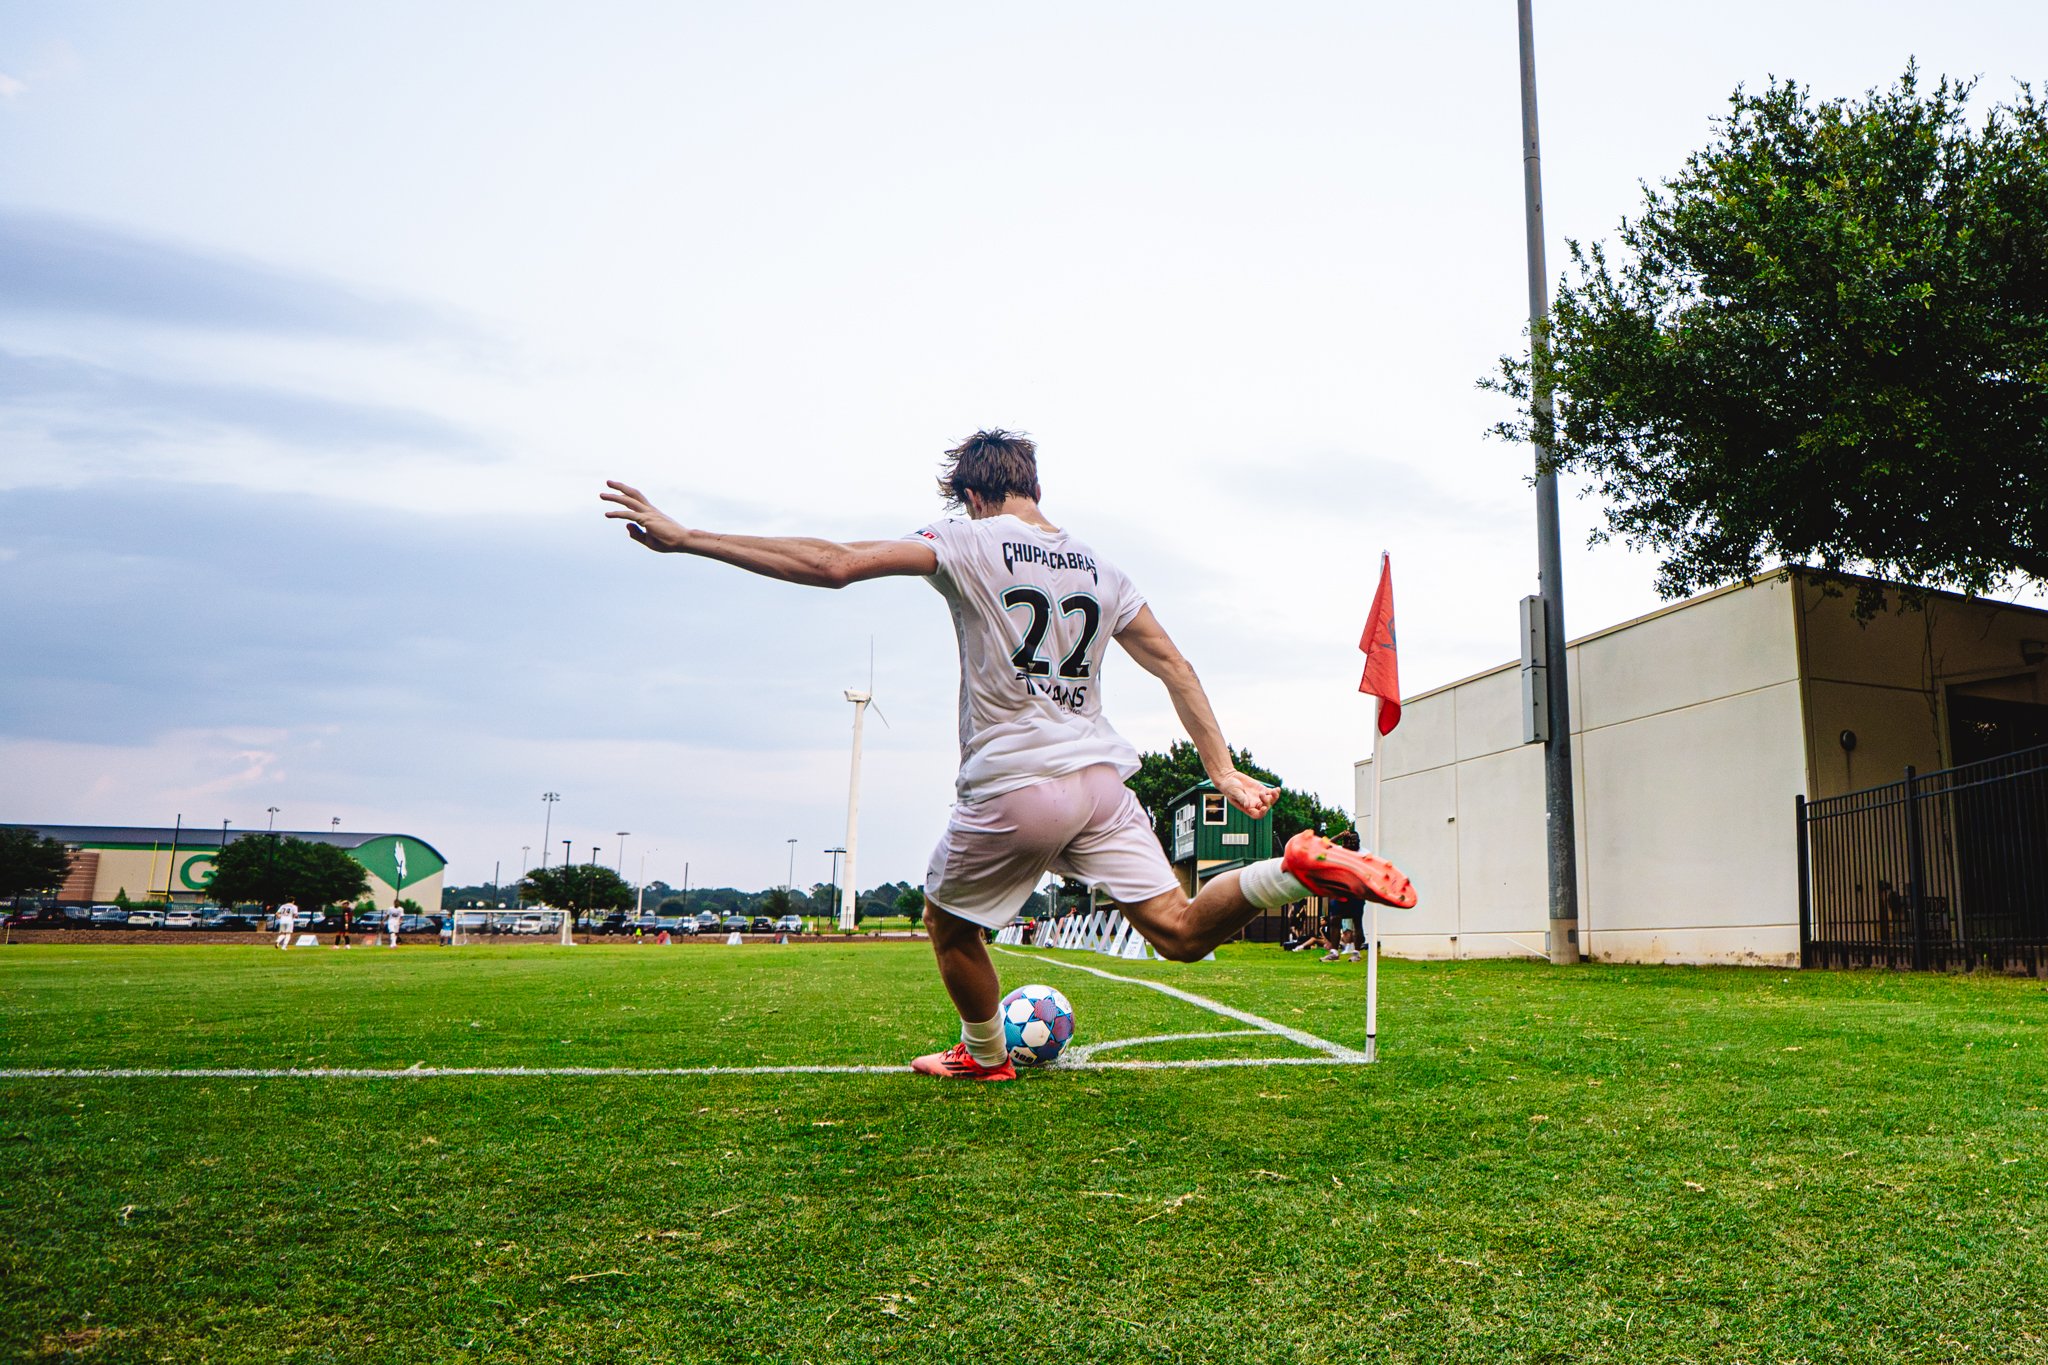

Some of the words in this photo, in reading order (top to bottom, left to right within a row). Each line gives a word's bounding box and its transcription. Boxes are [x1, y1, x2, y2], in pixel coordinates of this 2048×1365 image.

[1001, 542, 1098, 586] CHUPACABRAS
[1000, 585, 1100, 681] 22
[180, 854, 218, 890] G
